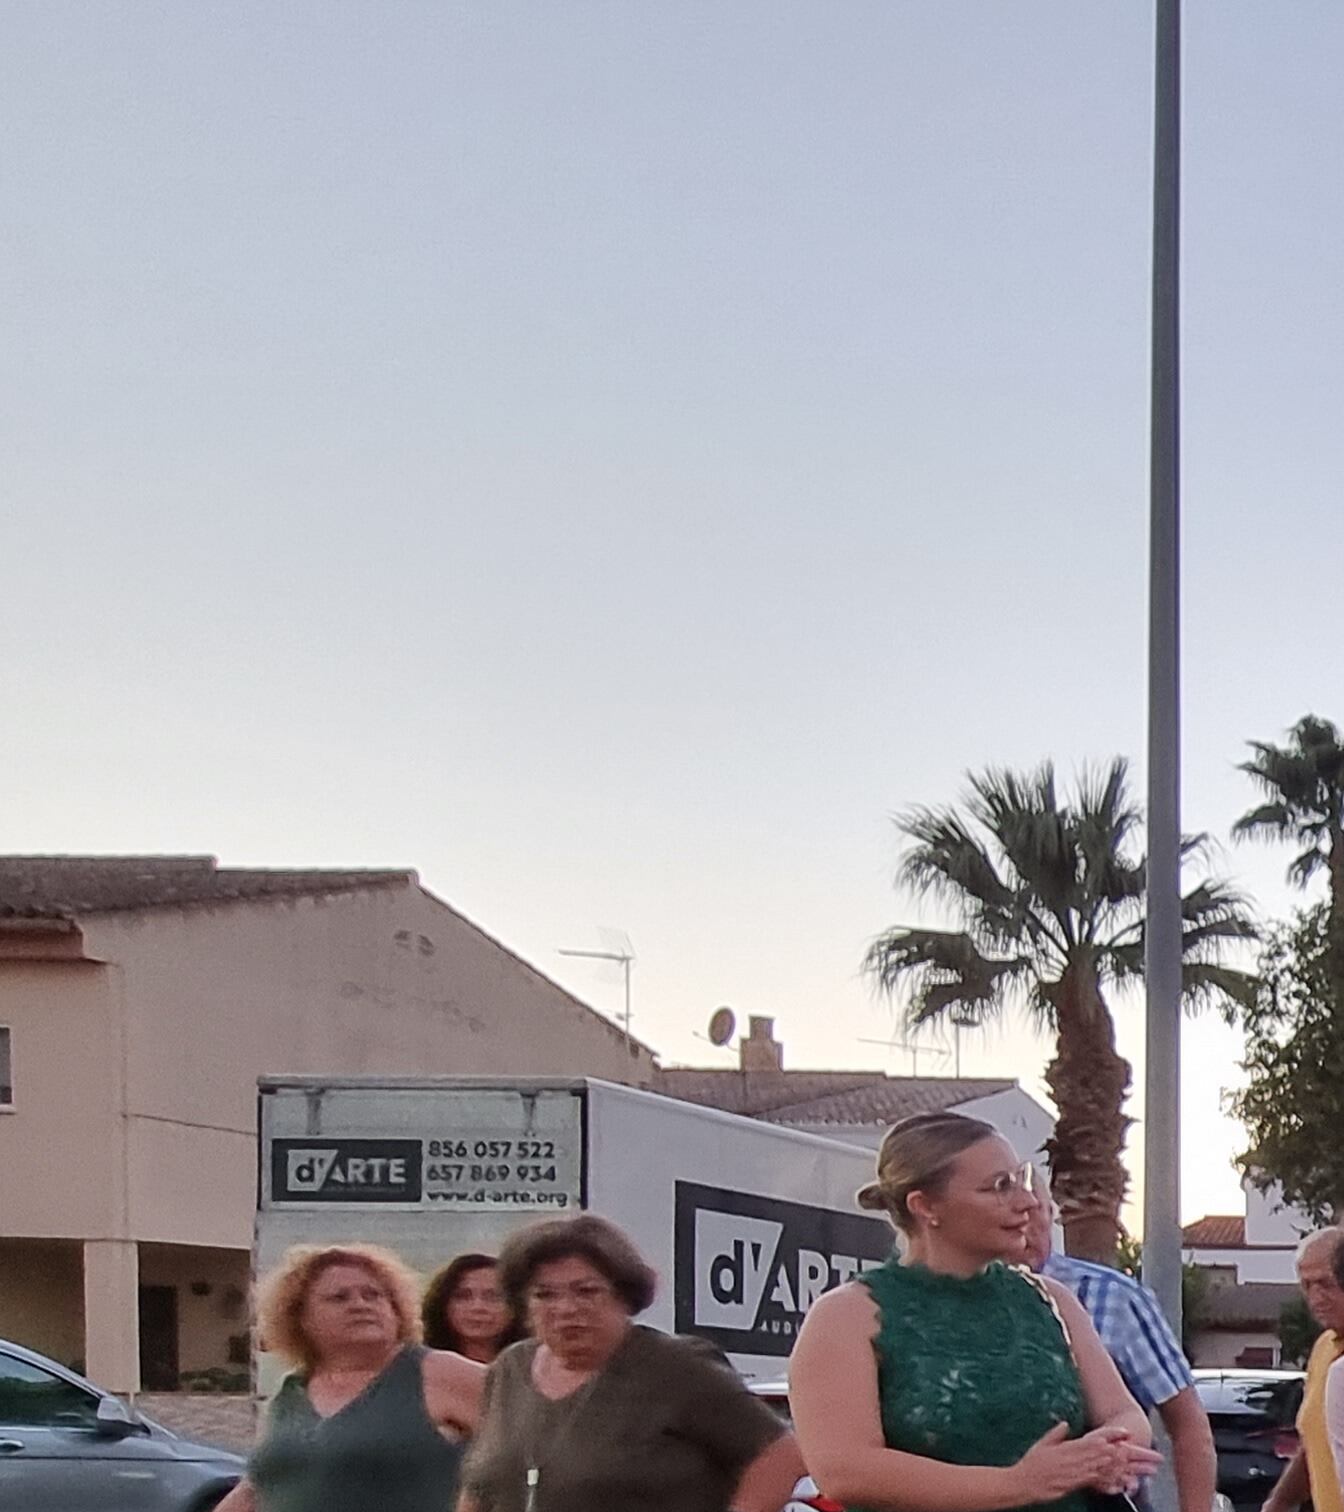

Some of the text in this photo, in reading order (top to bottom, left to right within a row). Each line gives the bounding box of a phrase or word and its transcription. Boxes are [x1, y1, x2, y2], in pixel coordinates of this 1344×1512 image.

[428, 1140, 555, 1159] 856 057 522
[427, 1163, 556, 1182] 657 869 934
[427, 1188, 568, 1208] www.d-arte.org
